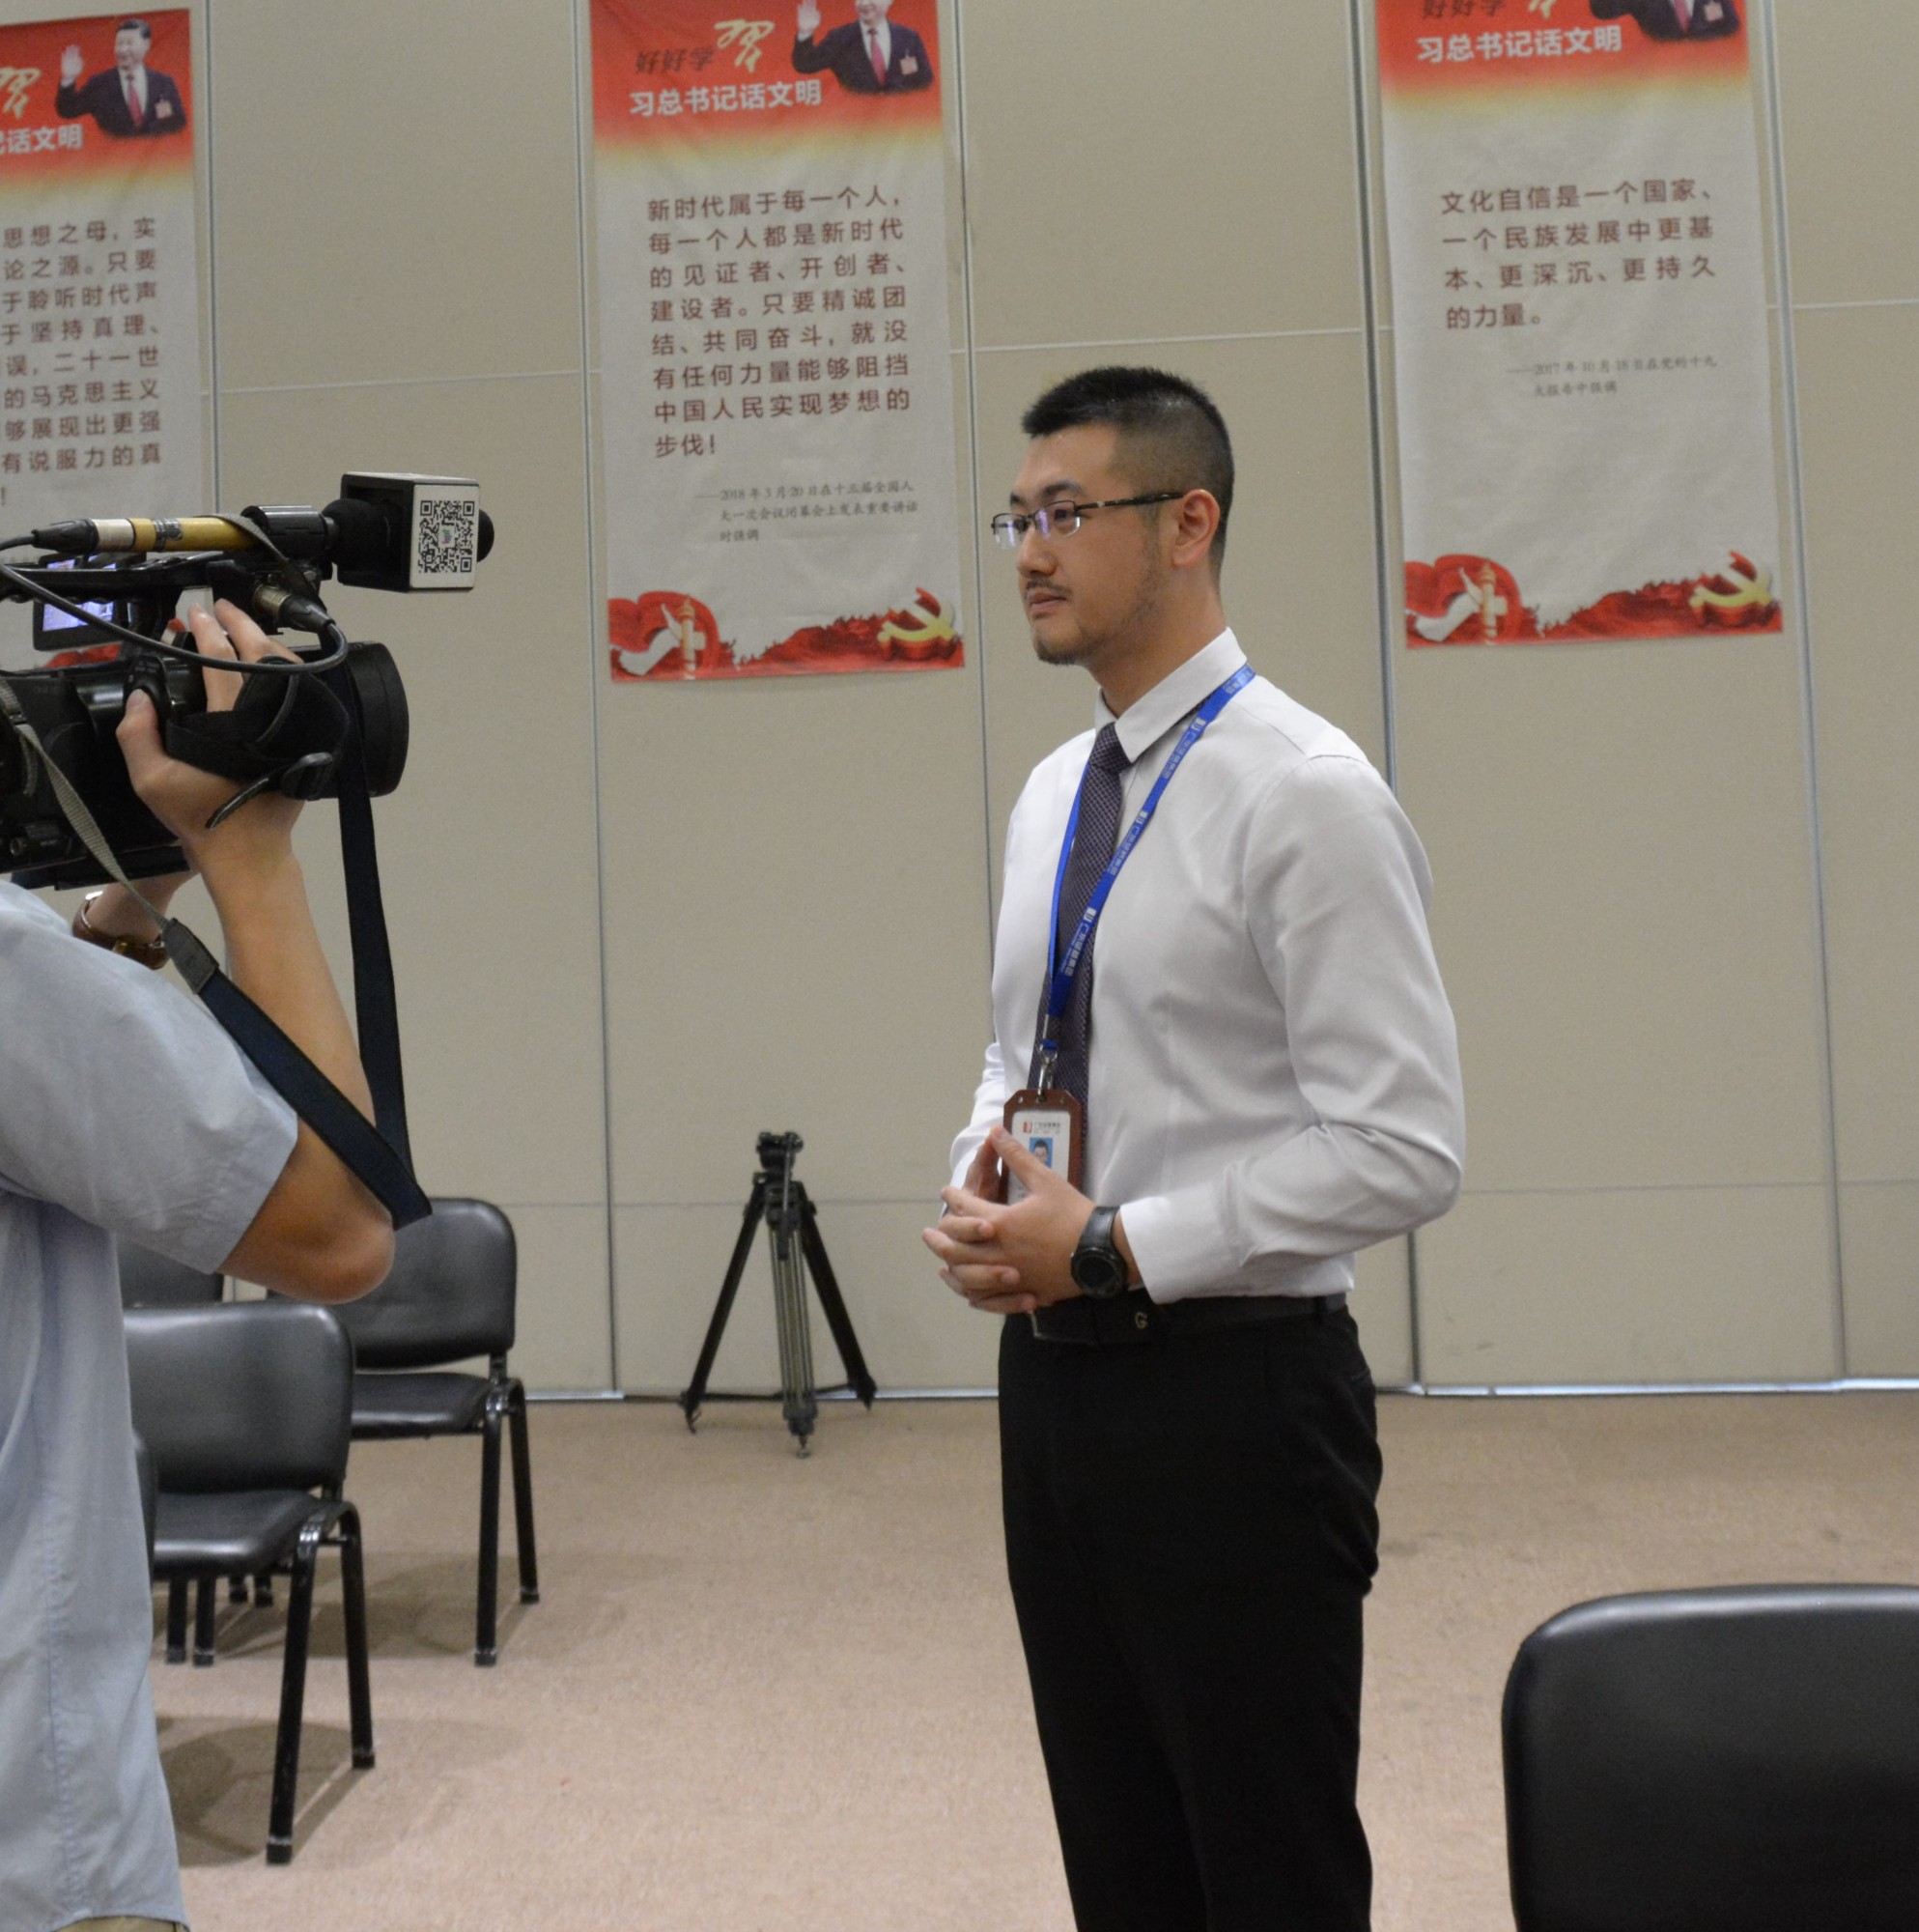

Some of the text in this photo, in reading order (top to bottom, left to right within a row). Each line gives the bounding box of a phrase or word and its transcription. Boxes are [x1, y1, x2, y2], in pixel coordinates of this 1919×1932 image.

[1416, 25, 1623, 64] 习总书记话文明
[629, 79, 823, 118] 习总书记话文明
[648, 184, 900, 222] 新时代属于每一个人，
[1441, 179, 1710, 214] 文化自信是一个国家、
[648, 217, 904, 255] 每一个人都是新时代
[1442, 215, 1713, 250] 一个民族发展中更基
[4, 248, 156, 280] 论之源。只要
[650, 252, 905, 289] 的见证者、开创者、
[1445, 254, 1716, 290] 本、更深沉、更持久
[2, 281, 157, 314] 于聆听时代声
[650, 286, 906, 323] 建设者。只要精诚团
[2, 314, 158, 345] 于坚持真理、
[1446, 302, 1541, 330] 的力量。
[652, 320, 907, 356] 结、共同奋斗，就没
[653, 354, 909, 390] 有任何力量能够阻挡
[4, 378, 160, 410] 的马克思主义
[655, 388, 910, 424] 中国人民实现梦想的
[5, 411, 160, 441] 够展现出更强
[2, 442, 161, 473] 有说服力的真
